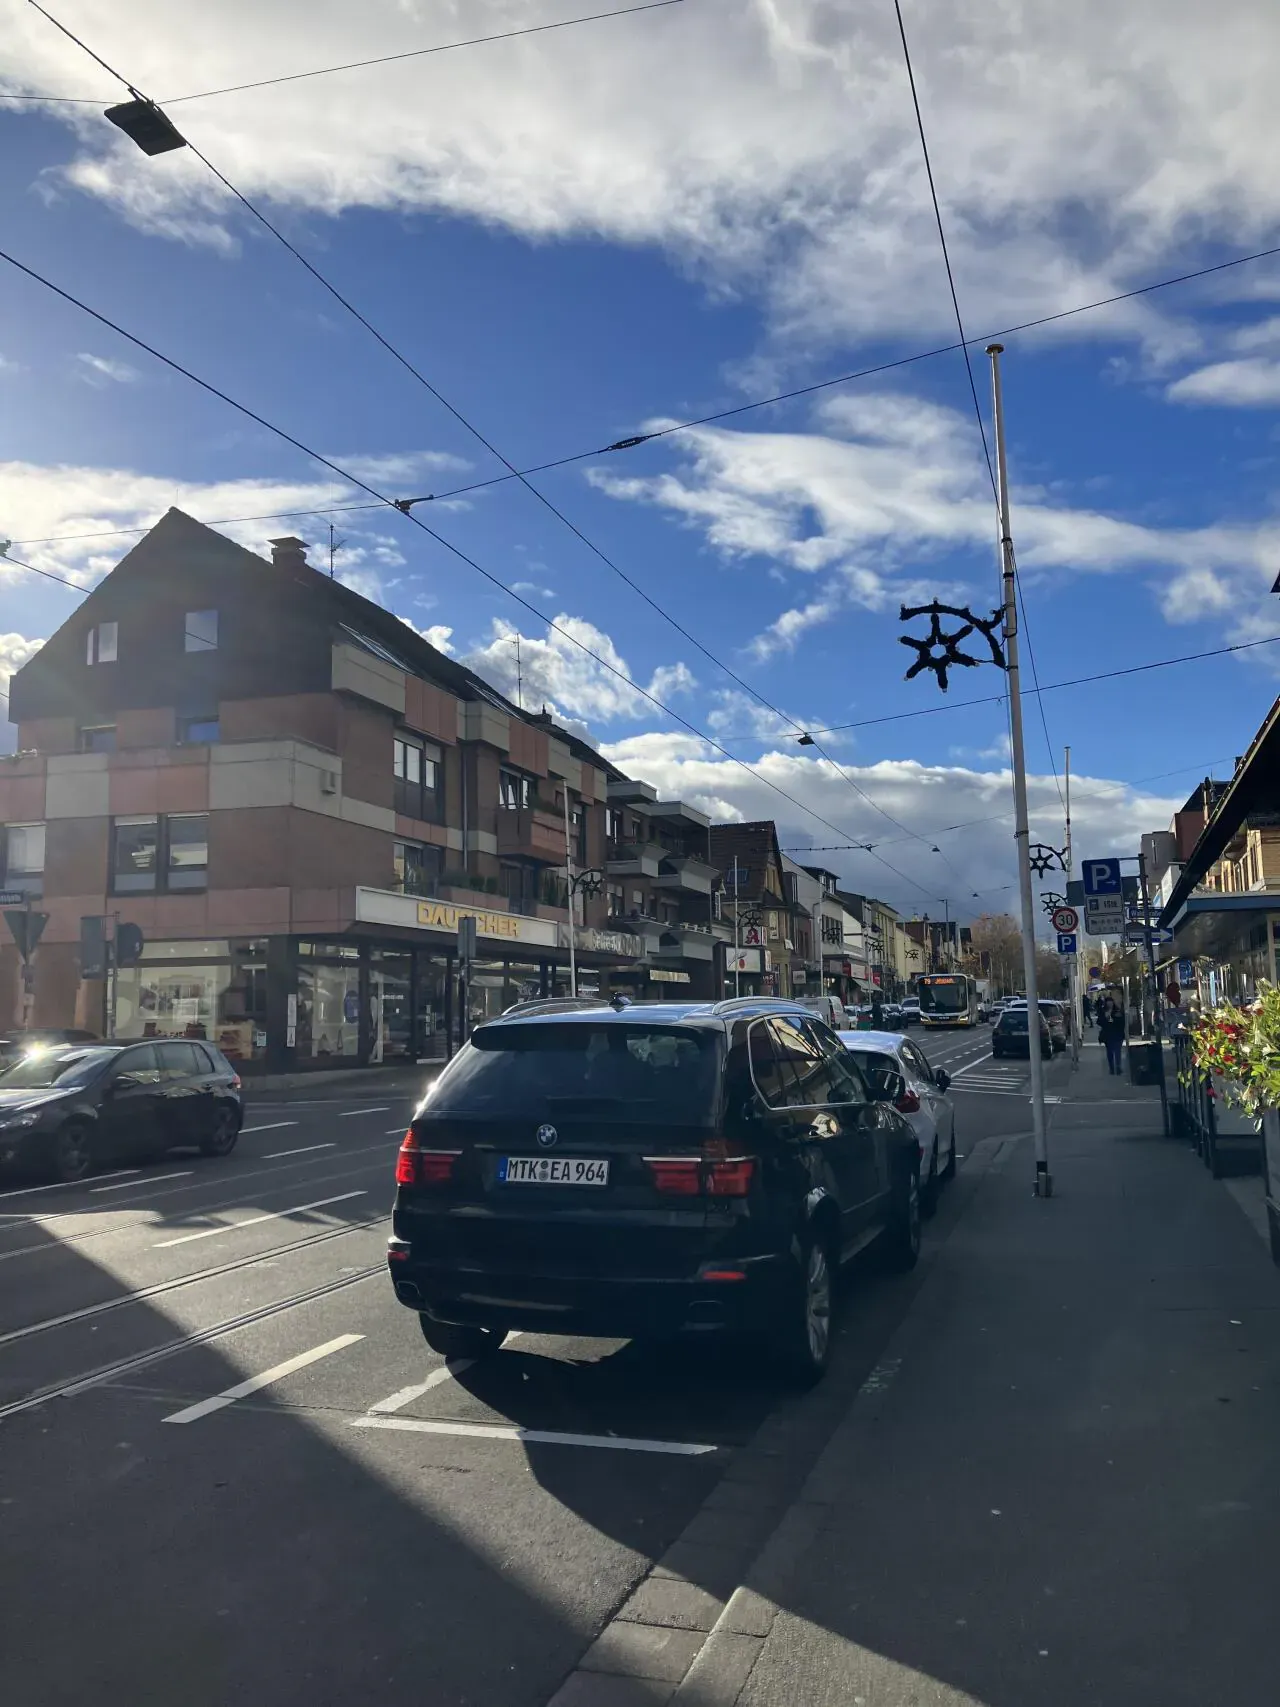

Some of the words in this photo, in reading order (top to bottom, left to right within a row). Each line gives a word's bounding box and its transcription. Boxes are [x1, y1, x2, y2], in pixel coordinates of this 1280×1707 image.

[1091, 865, 1111, 891] P
[418, 902, 519, 936] DAUCHER
[1058, 914, 1073, 926] 30
[1061, 936, 1072, 952] P
[508, 1159, 540, 1180] MTK
[550, 1161, 571, 1182] EA
[576, 1162, 605, 1183] 964
